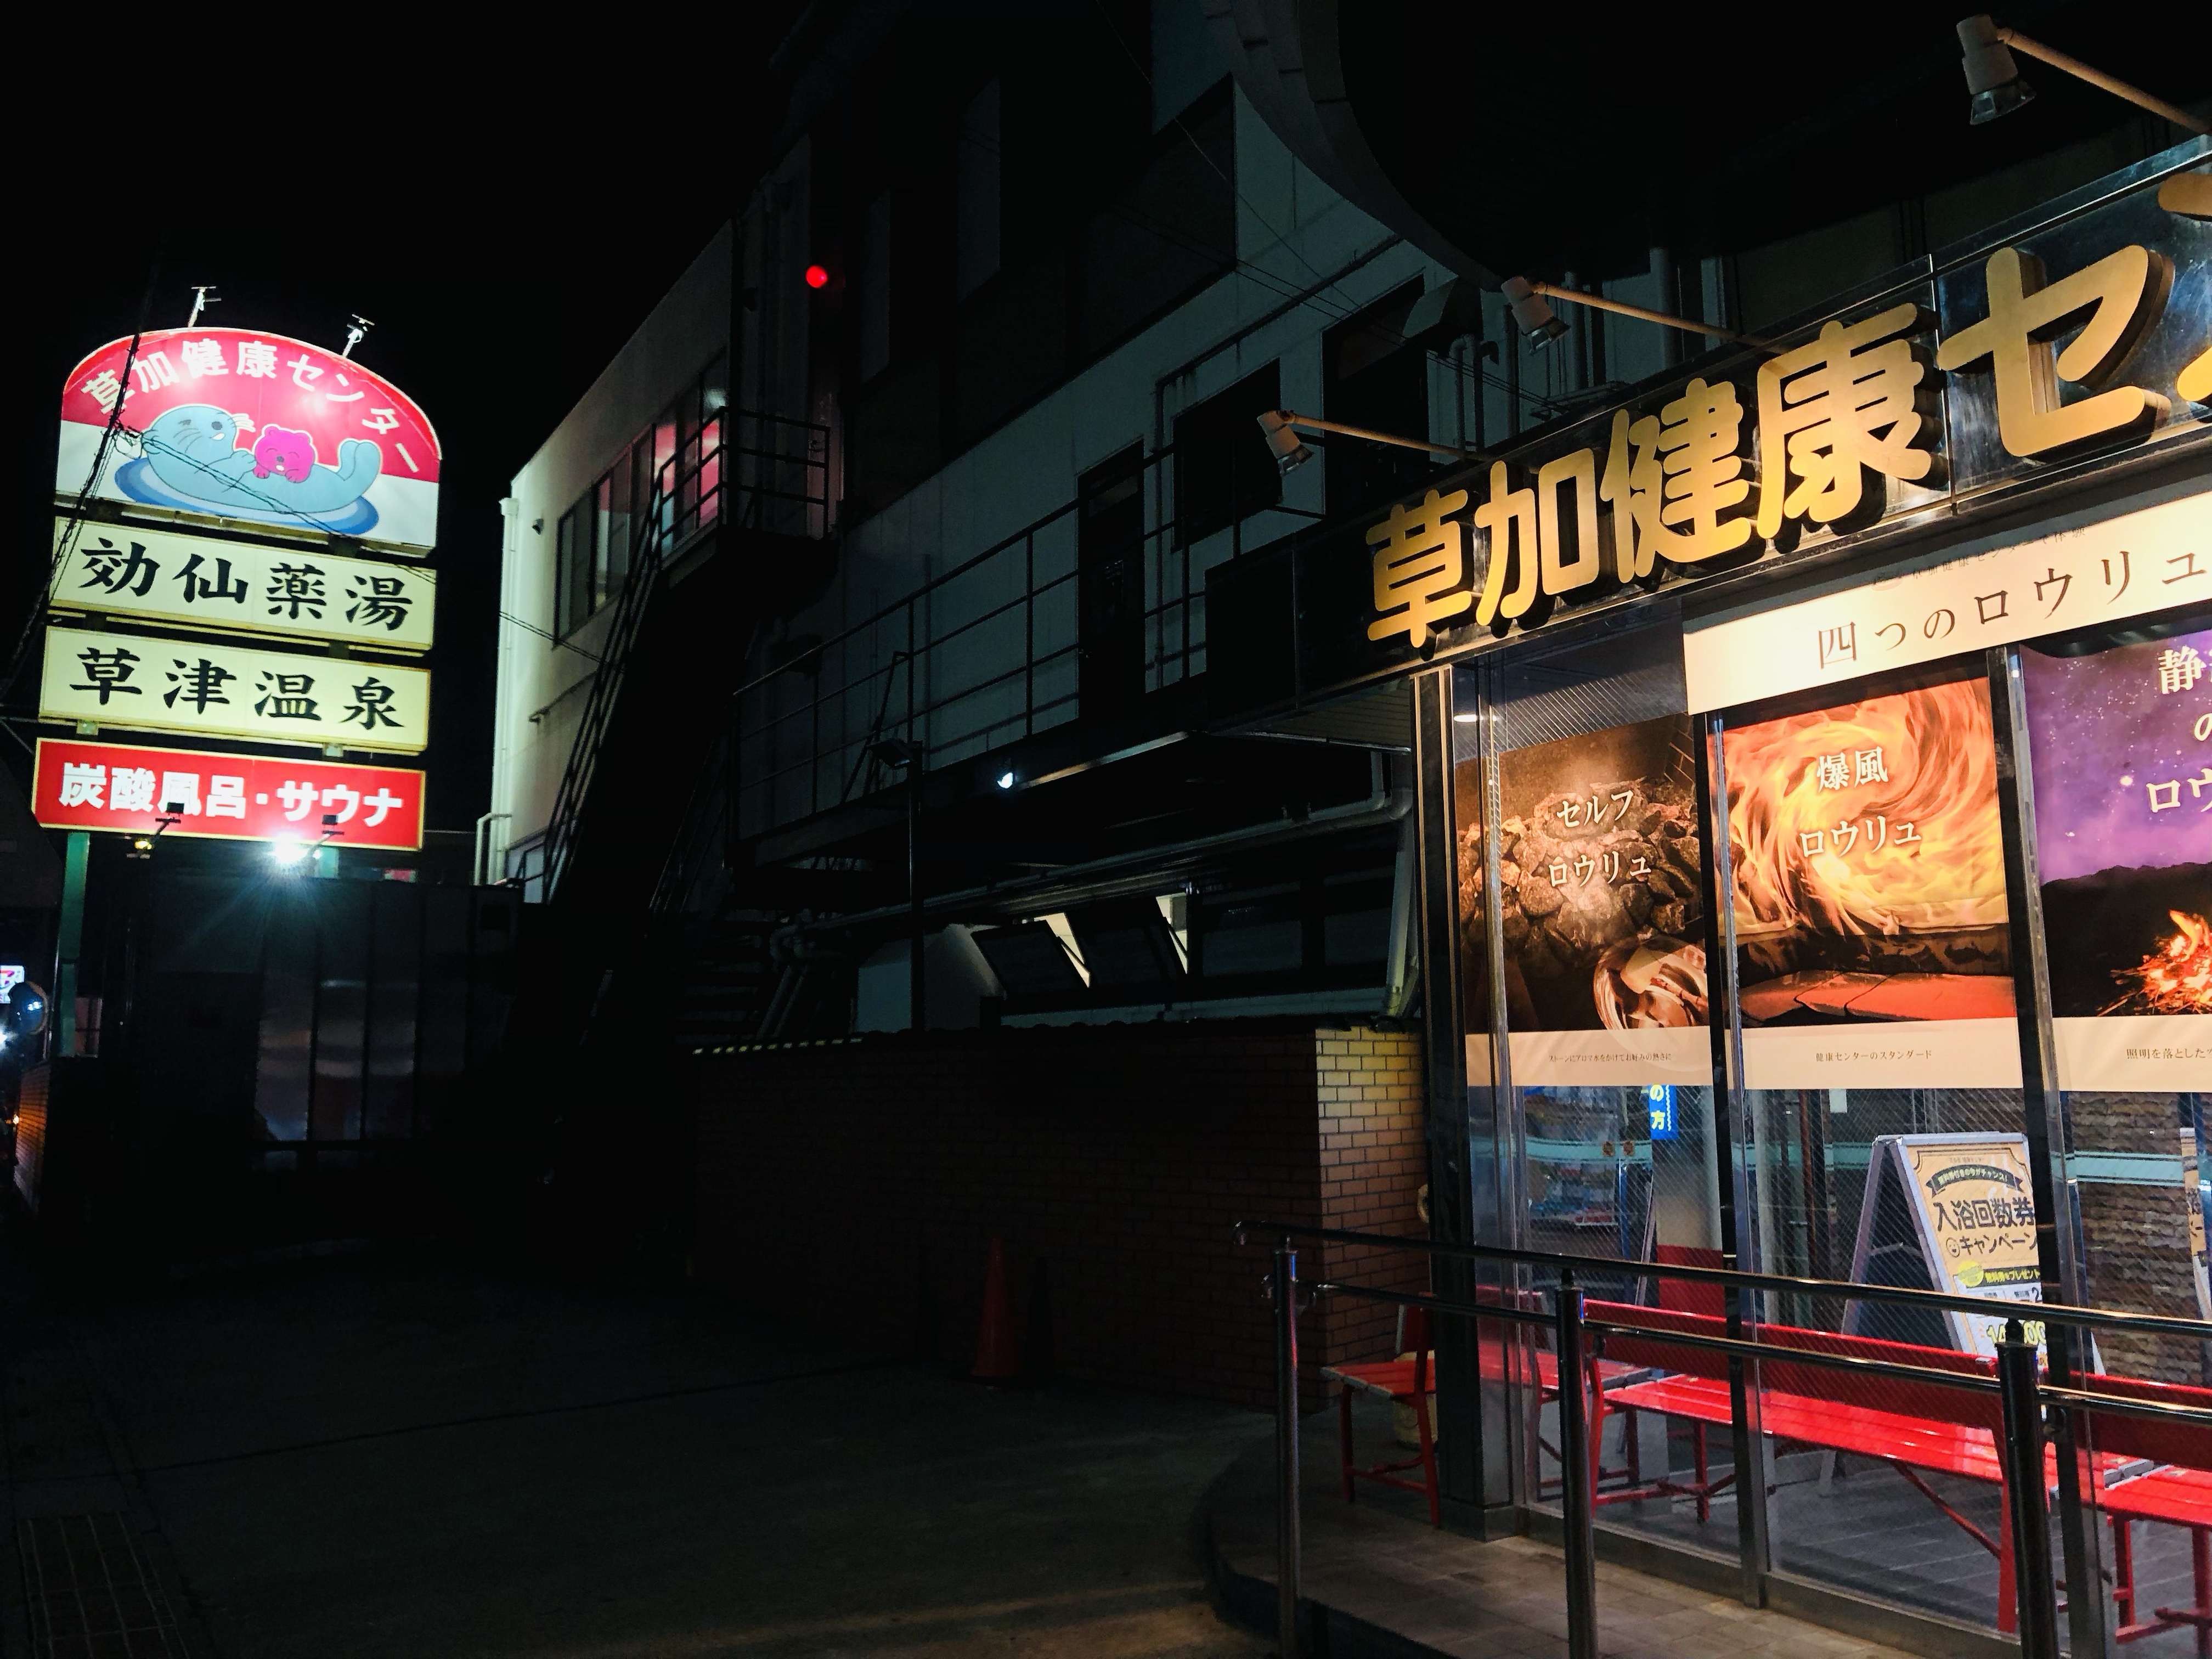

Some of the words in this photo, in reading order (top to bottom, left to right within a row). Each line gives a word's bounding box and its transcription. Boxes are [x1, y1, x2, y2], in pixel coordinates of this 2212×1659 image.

[81, 338, 419, 473] 草加健康センター
[78, 537, 413, 631] 効仙薬湯
[1818, 551, 2207, 669] 四つのロウリュ
[70, 647, 404, 730] 草津温泉
[2157, 646, 2212, 695] 静
[1817, 747, 1889, 793] 爆風
[59, 763, 402, 827] 炭酸風呂・サウナ
[1556, 790, 1634, 829] セルフ
[1799, 815, 1922, 857] ロウリュ
[1548, 851, 1651, 887] ロウリュ
[1816, 1049, 1932, 1062] 健康センターのスタンダード
[1933, 1196, 2035, 1232] 入浴回数券
[1959, 1232, 2037, 1255] キャンペーン
